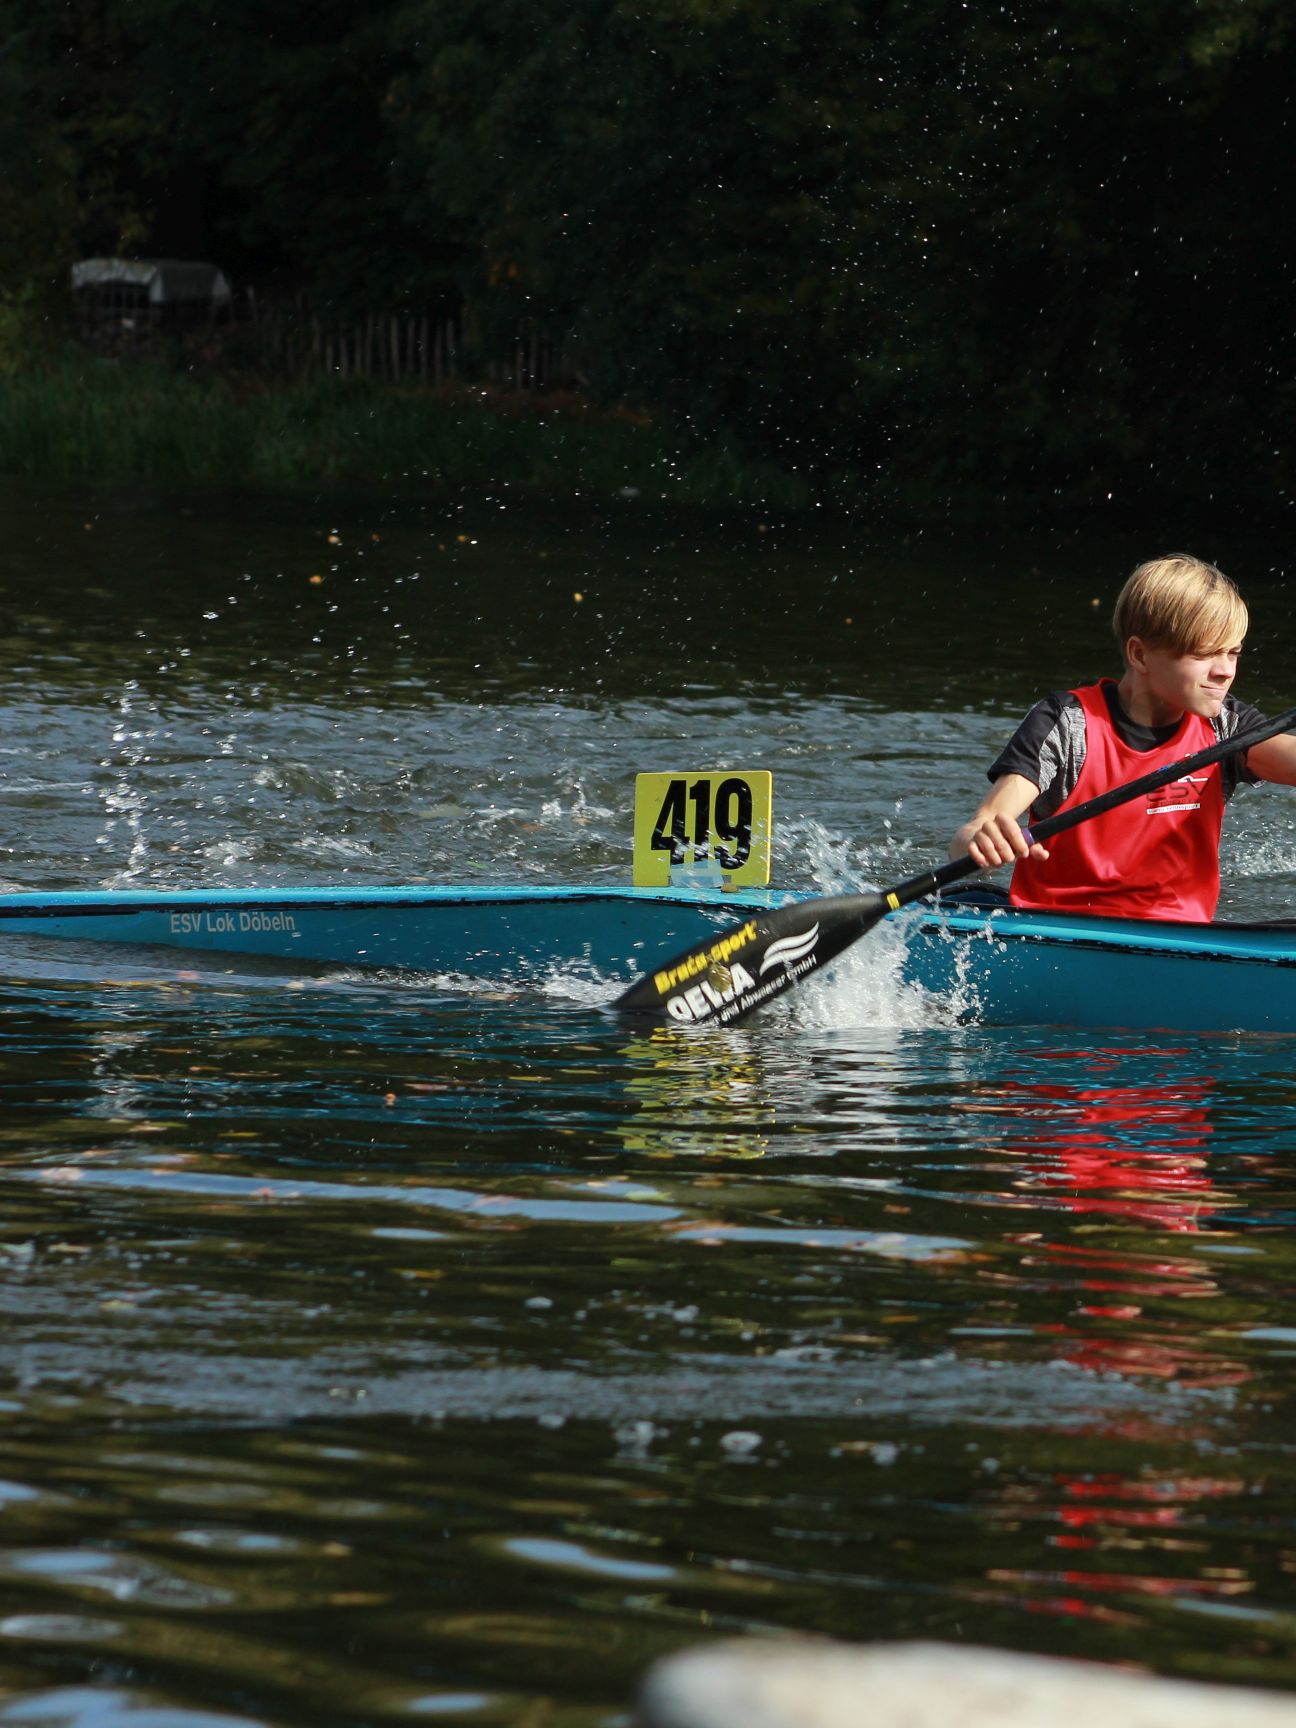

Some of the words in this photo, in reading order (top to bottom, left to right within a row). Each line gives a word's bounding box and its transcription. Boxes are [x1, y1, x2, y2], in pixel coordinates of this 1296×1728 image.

[651, 778, 753, 870] 419
[170, 912, 201, 933] ESV
[206, 912, 236, 932] Lok
[239, 911, 296, 932] Döbeln
